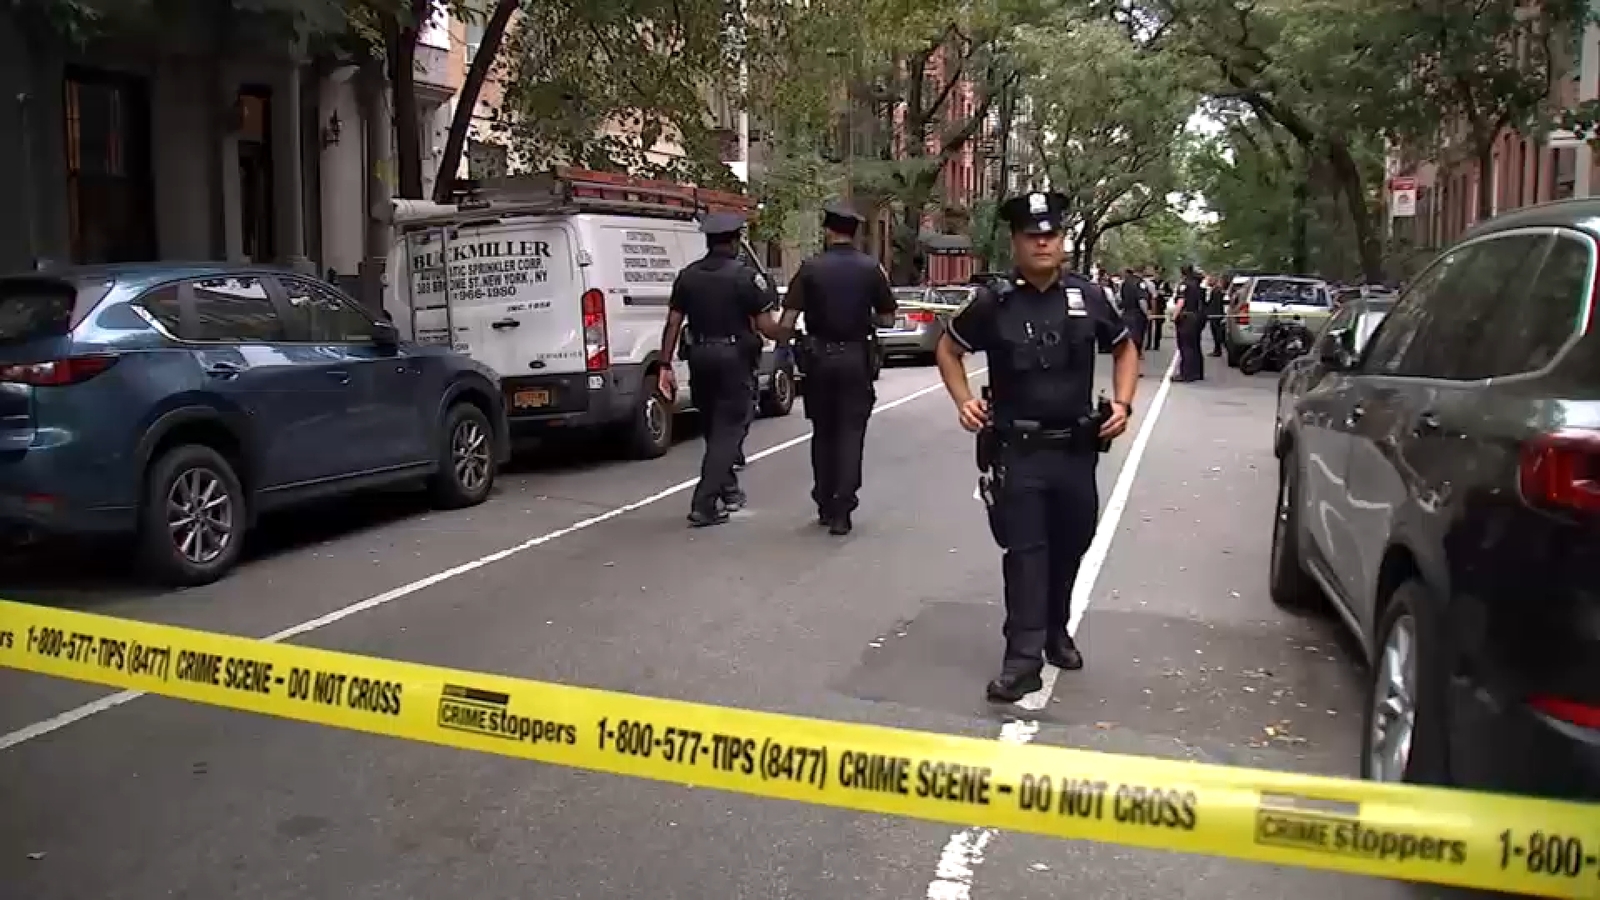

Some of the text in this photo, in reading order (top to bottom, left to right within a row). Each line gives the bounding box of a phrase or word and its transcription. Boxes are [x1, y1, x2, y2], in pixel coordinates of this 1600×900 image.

[468, 260, 516, 276] SPRINKLER
[26, 625, 126, 671] 1-800-577-TIPS
[127, 639, 171, 683] (8477)
[175, 650, 222, 686] CRIME
[224, 657, 273, 694] SCENE
[288, 668, 311, 701] DO
[313, 671, 347, 706] NOT
[347, 676, 403, 716] CROSS
[597, 717, 756, 775] 1-800-577-TIPS
[759, 737, 828, 790] (8477)
[838, 750, 911, 795] CRIME
[914, 760, 992, 806] SCENE
[1019, 773, 1053, 812] DO
[1058, 777, 1109, 821] NOT
[1113, 783, 1198, 831] CROSS
